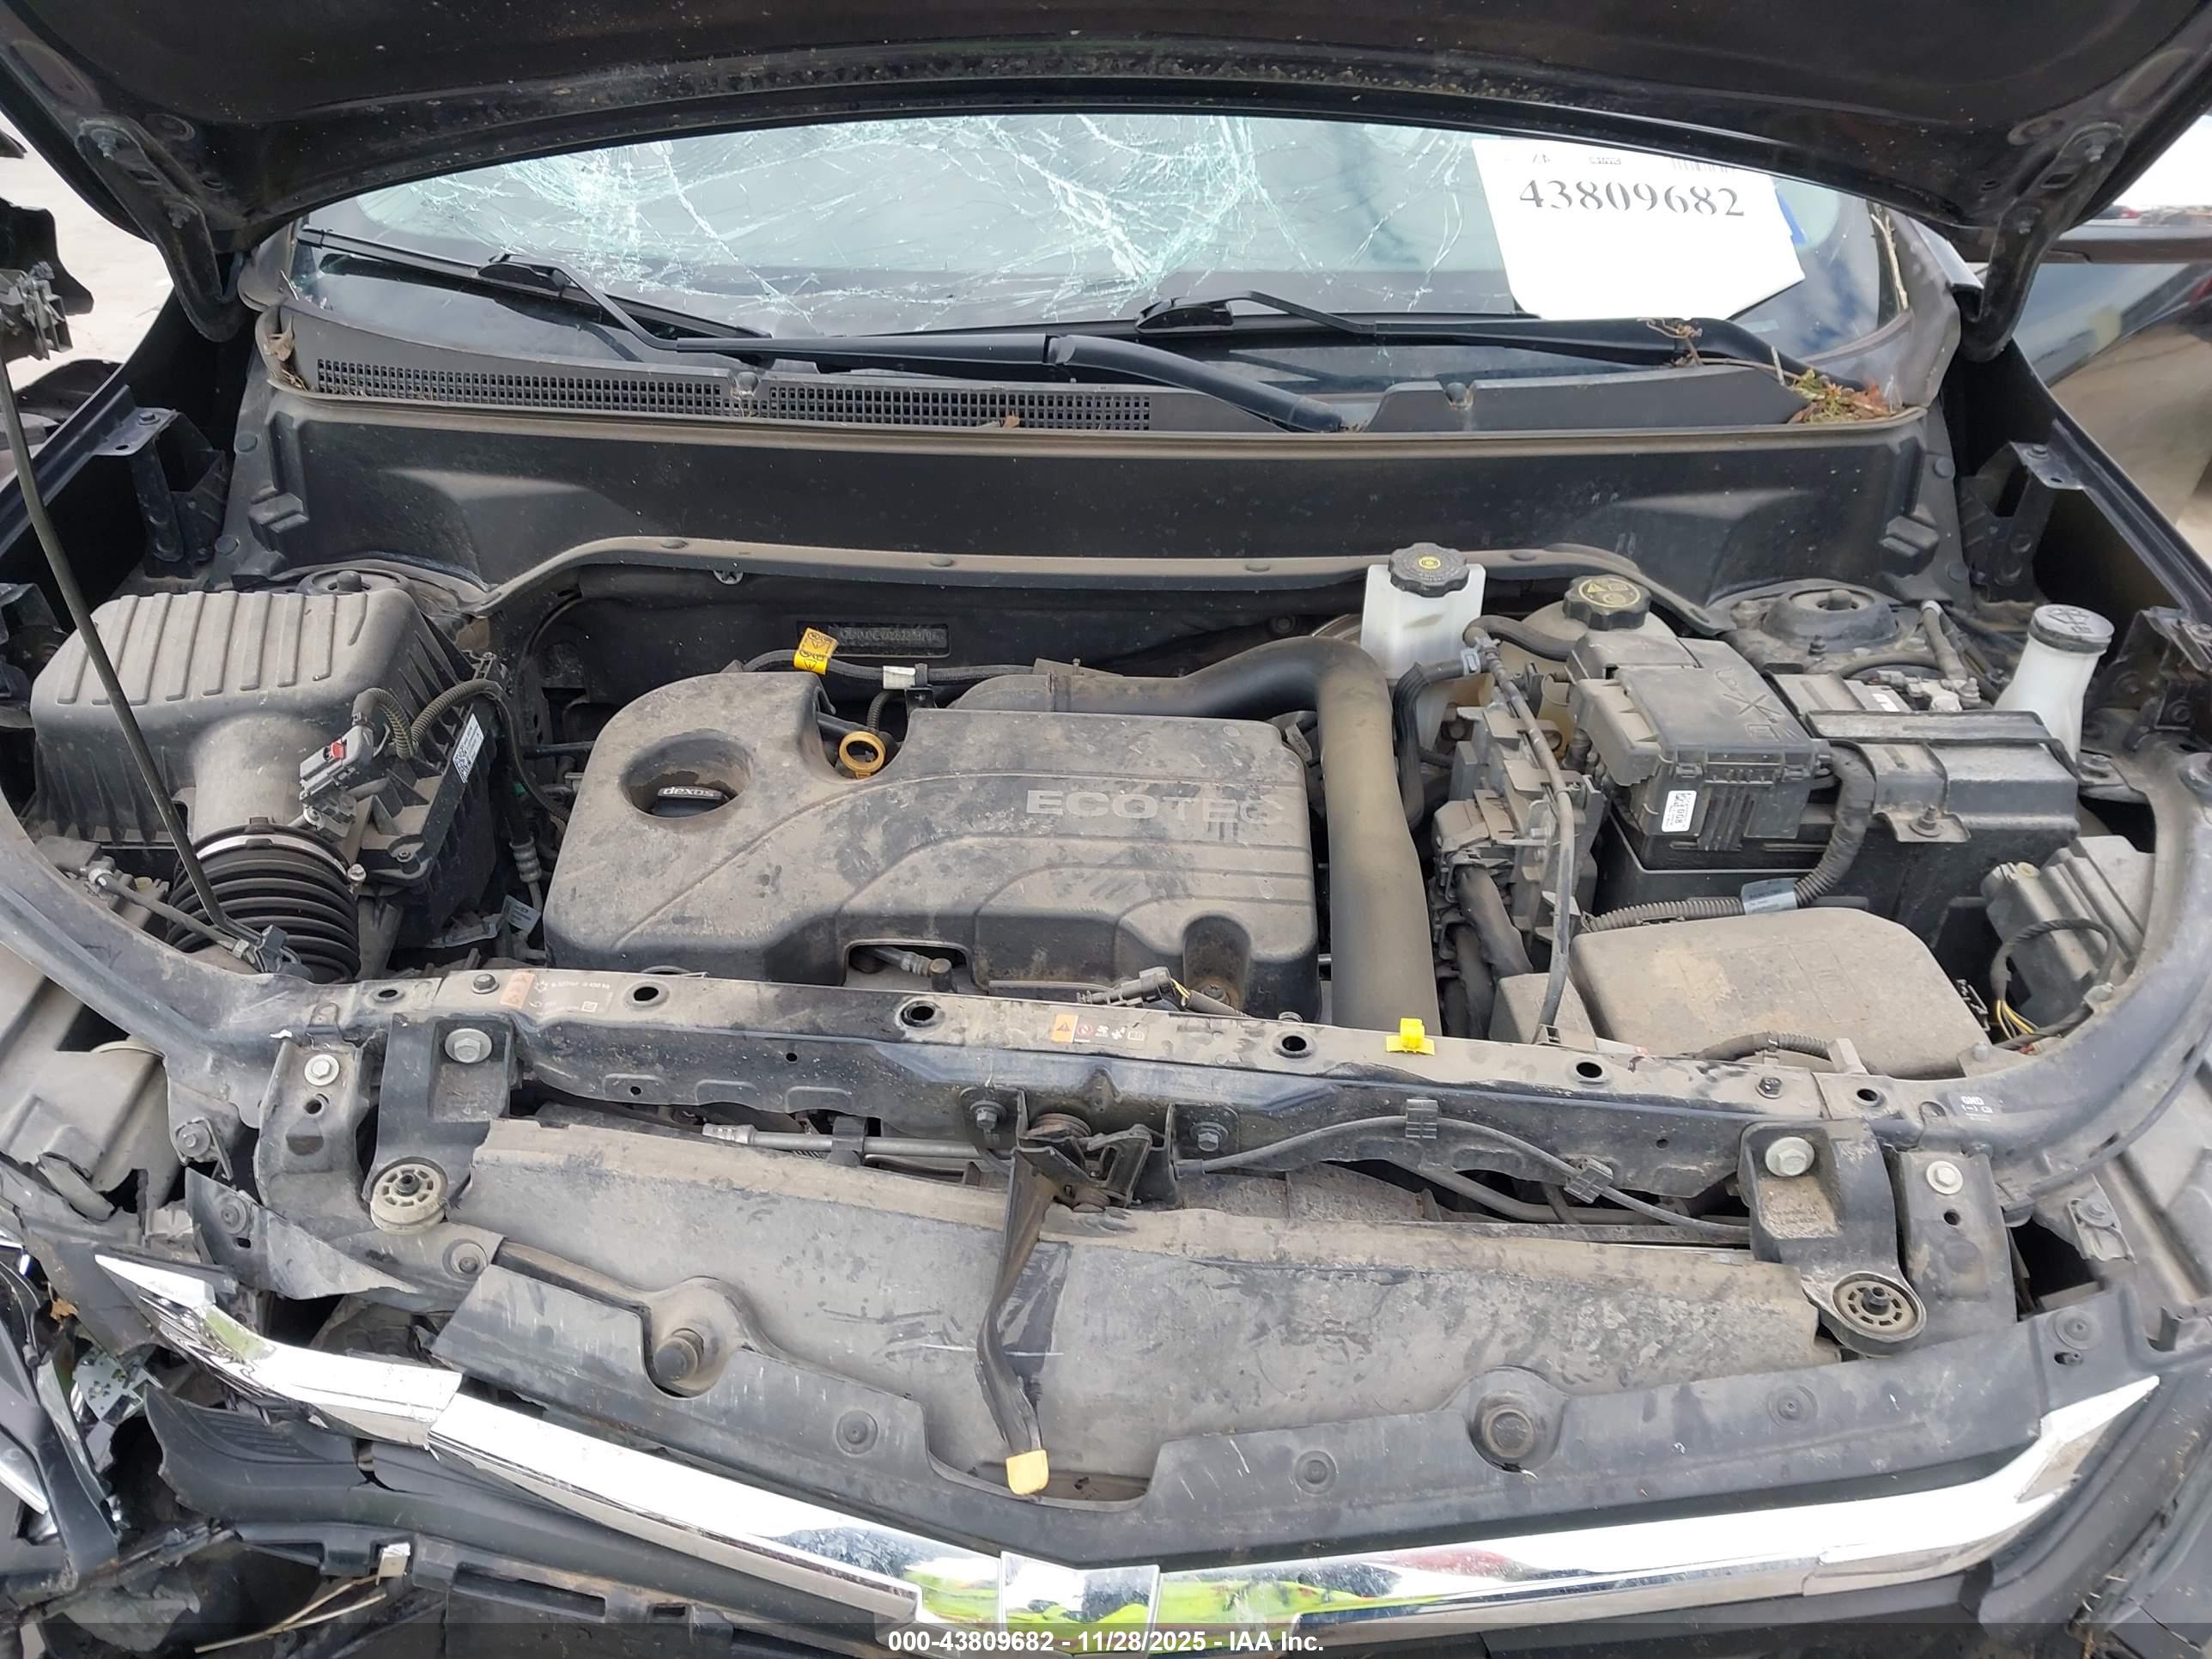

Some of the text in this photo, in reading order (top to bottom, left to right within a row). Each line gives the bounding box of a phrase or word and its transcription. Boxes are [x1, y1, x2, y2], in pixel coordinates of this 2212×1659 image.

[1520, 179, 1744, 216] 43809682
[663, 787, 714, 797] dexos
[1026, 789, 1285, 824] ECOTEC
